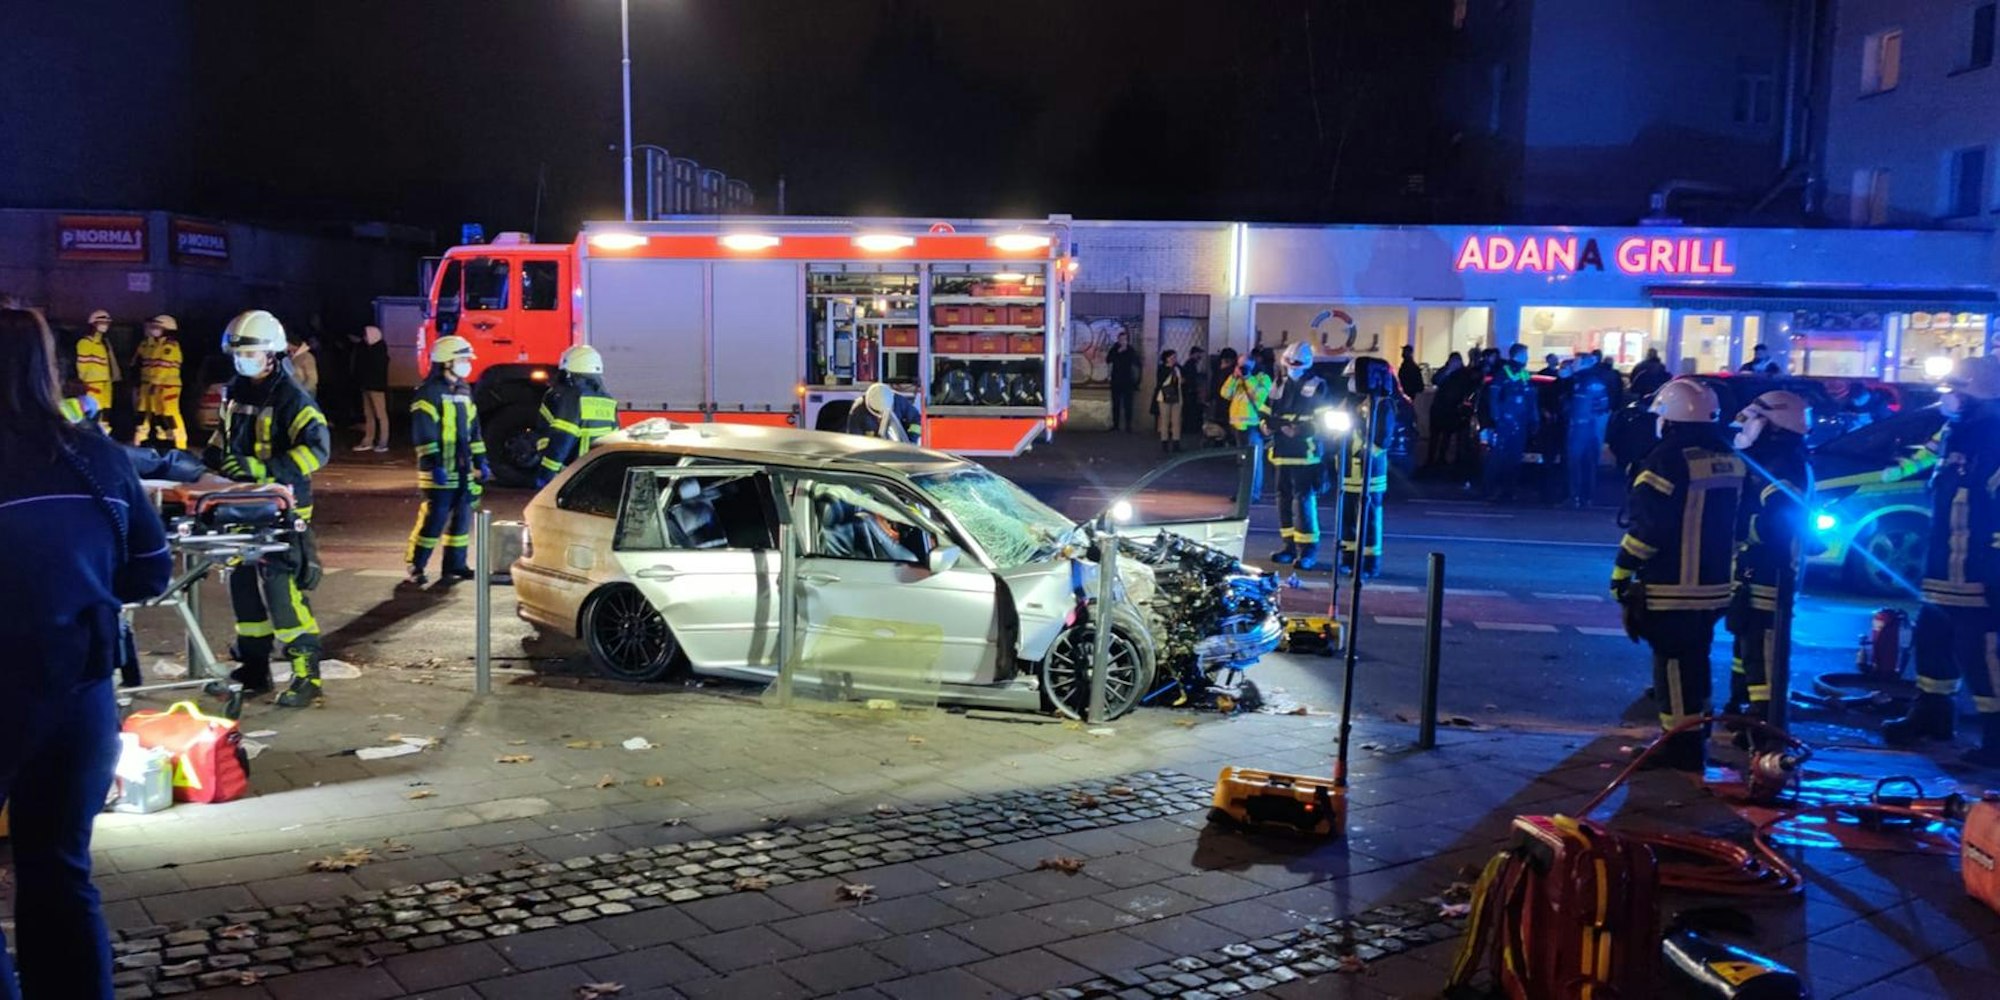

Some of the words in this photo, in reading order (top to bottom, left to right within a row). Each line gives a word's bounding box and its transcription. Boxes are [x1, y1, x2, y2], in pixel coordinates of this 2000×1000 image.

[76, 229, 134, 243] NORMA
[189, 233, 226, 250] NORMA
[1456, 236, 1605, 271] ADANA
[1616, 237, 1735, 274] GRILL
